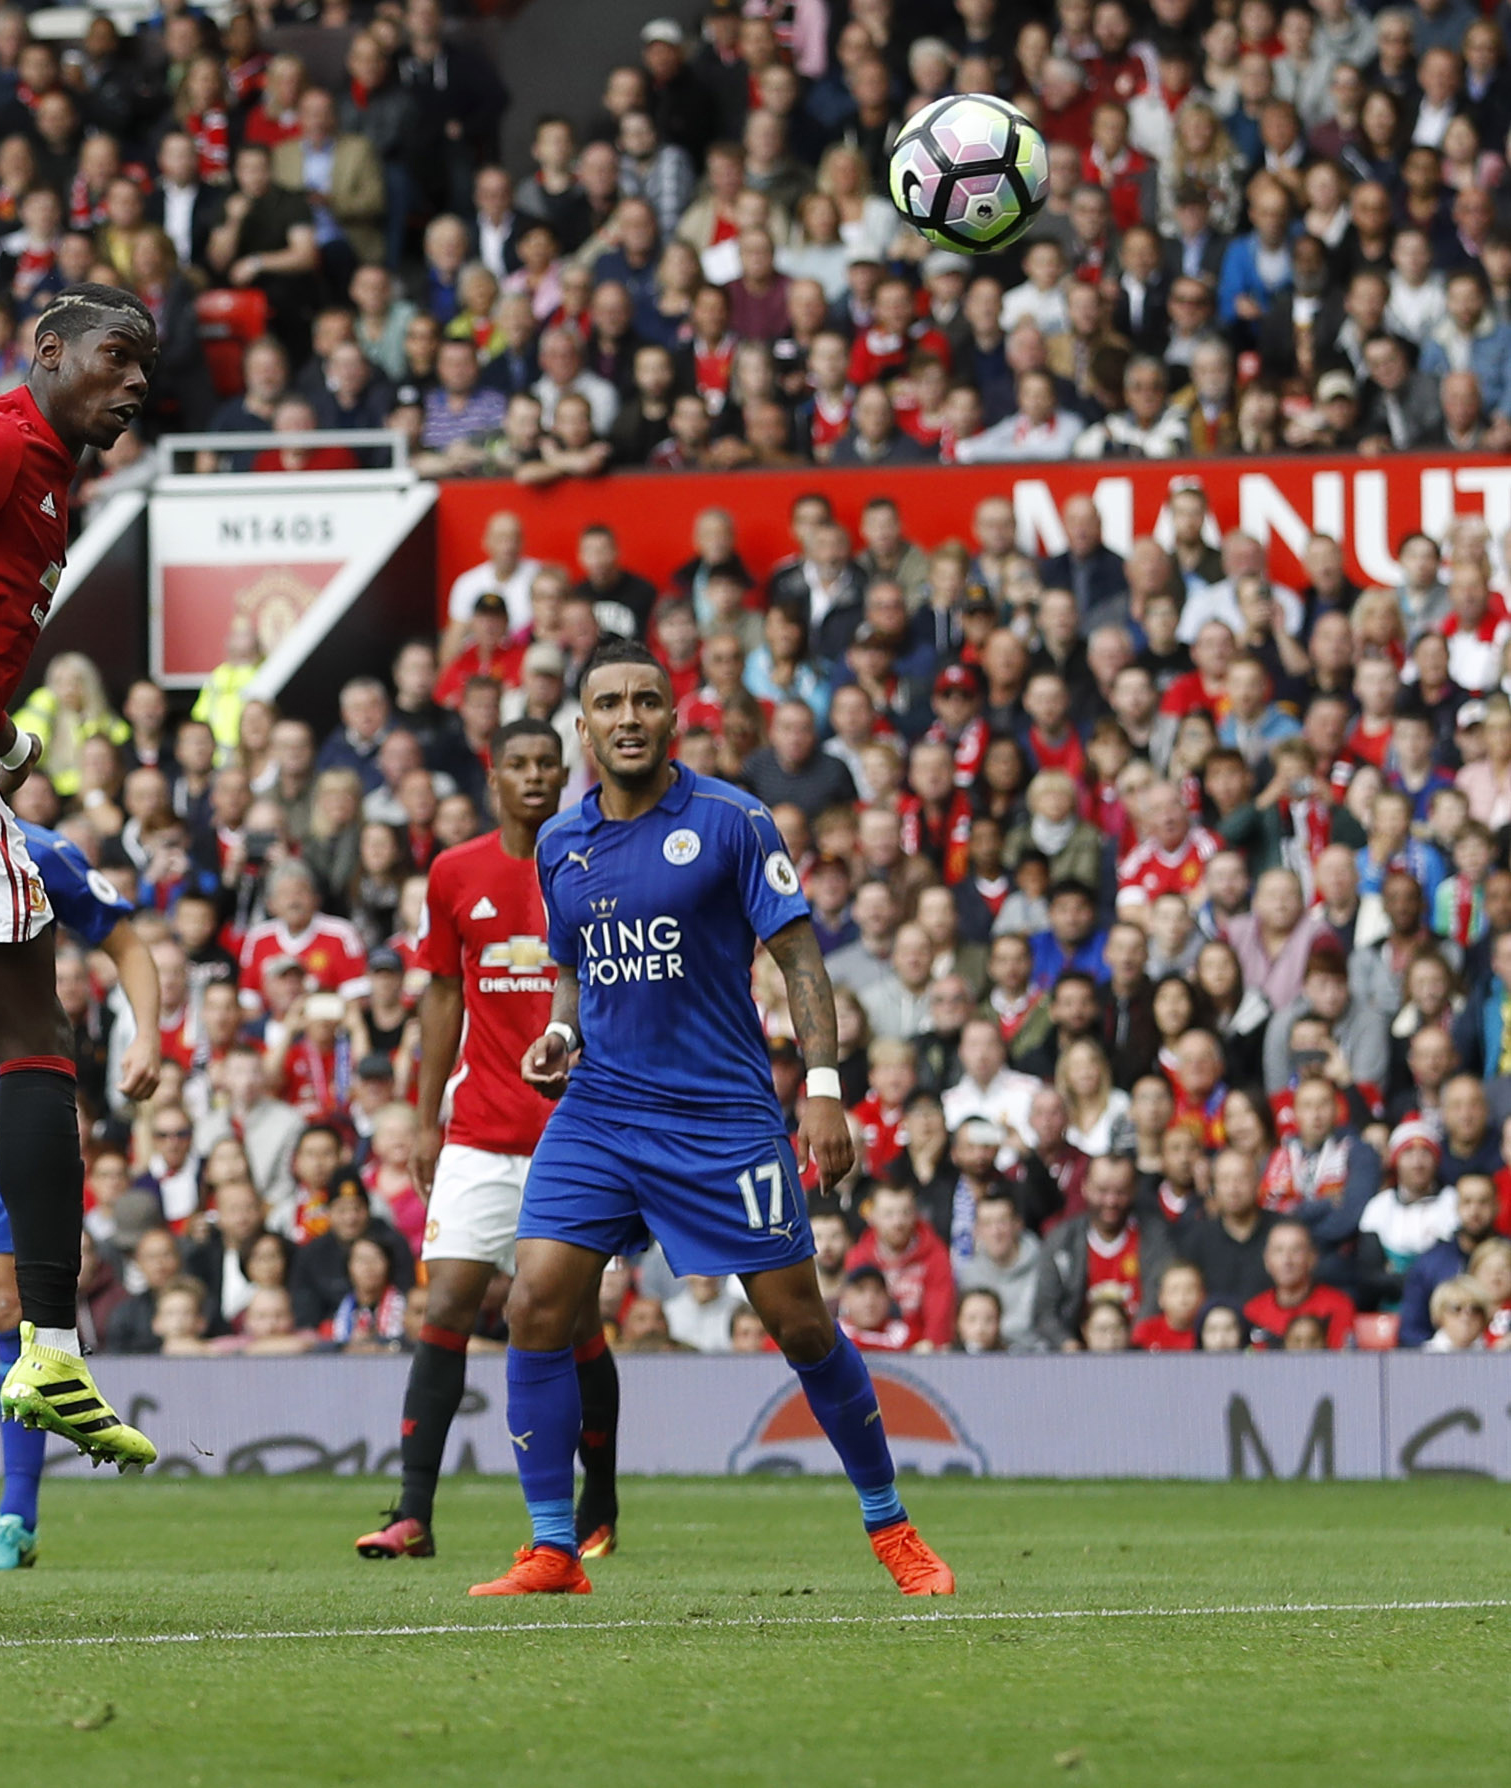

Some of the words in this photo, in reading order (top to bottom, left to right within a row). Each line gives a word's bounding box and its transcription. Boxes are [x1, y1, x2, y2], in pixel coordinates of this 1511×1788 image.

[580, 916, 682, 958] KING
[478, 976, 558, 993] CHEVROL
[588, 953, 685, 986] POWER
[736, 1161, 783, 1229] 17
